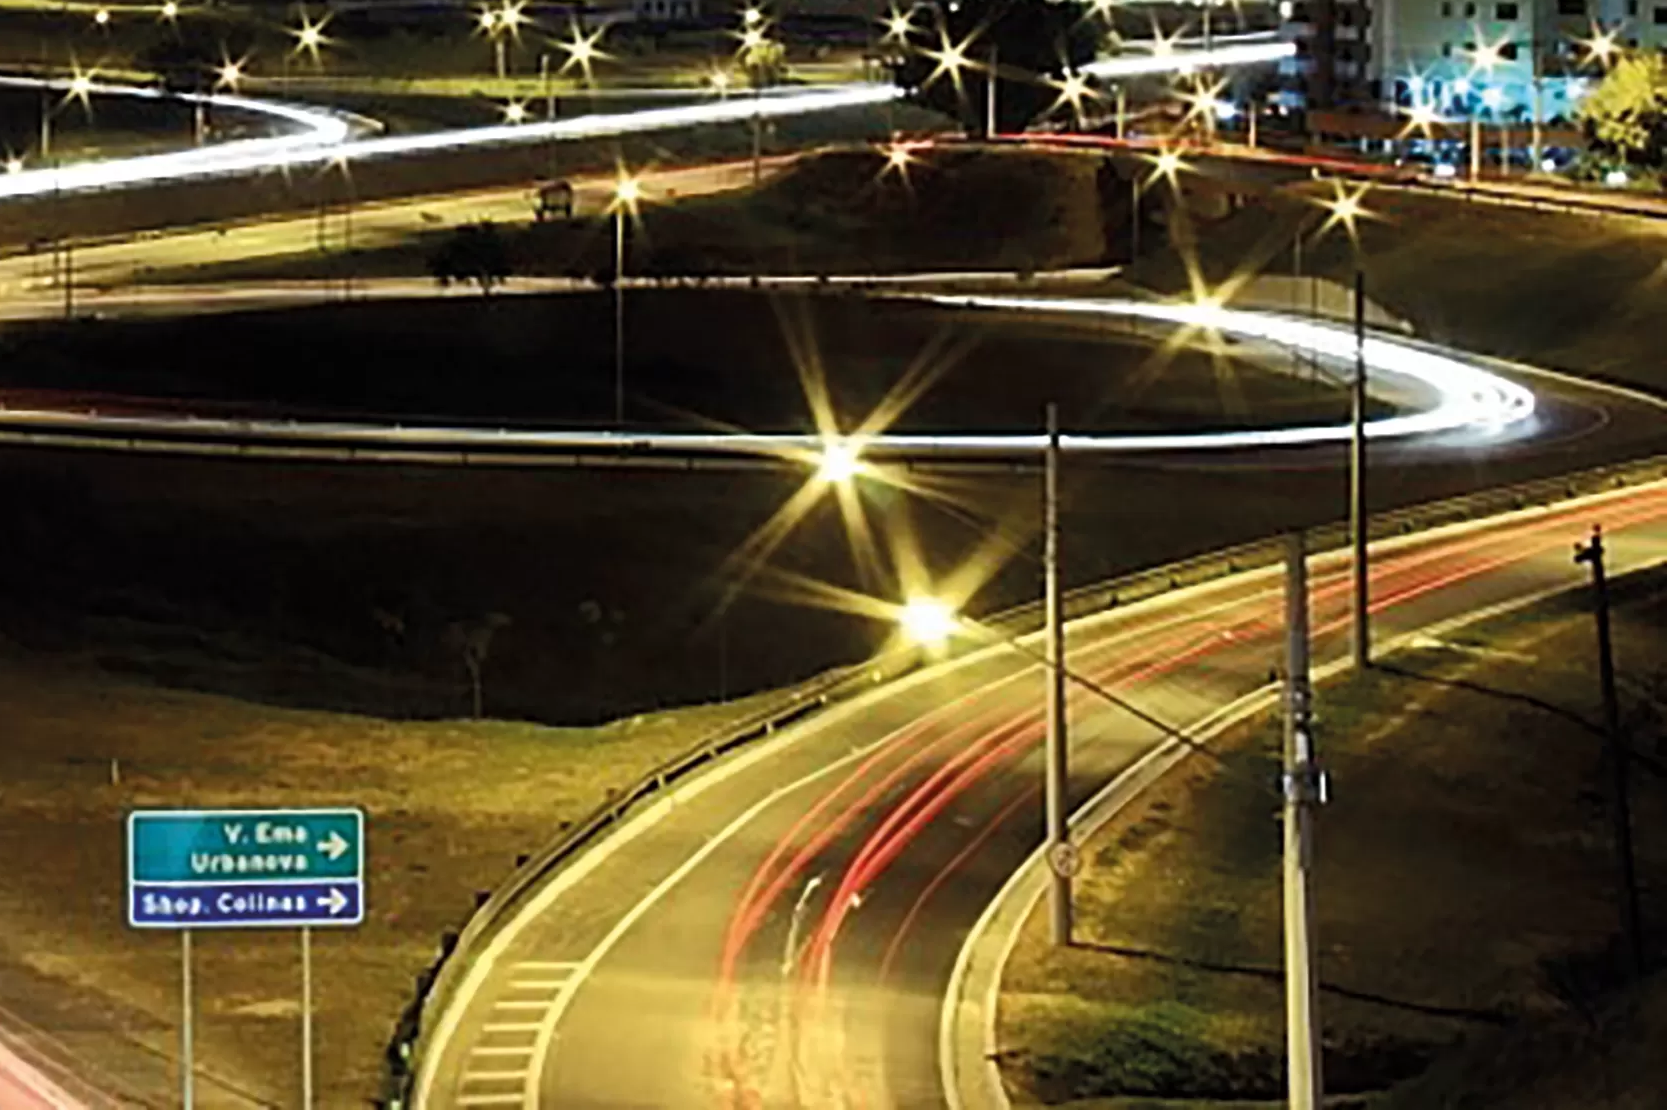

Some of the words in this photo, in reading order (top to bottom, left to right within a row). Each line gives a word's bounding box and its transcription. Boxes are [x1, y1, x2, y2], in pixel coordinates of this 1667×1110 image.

[255, 821, 308, 844] Ema
[191, 852, 308, 874] Urbanova
[216, 892, 307, 913] Colinas
